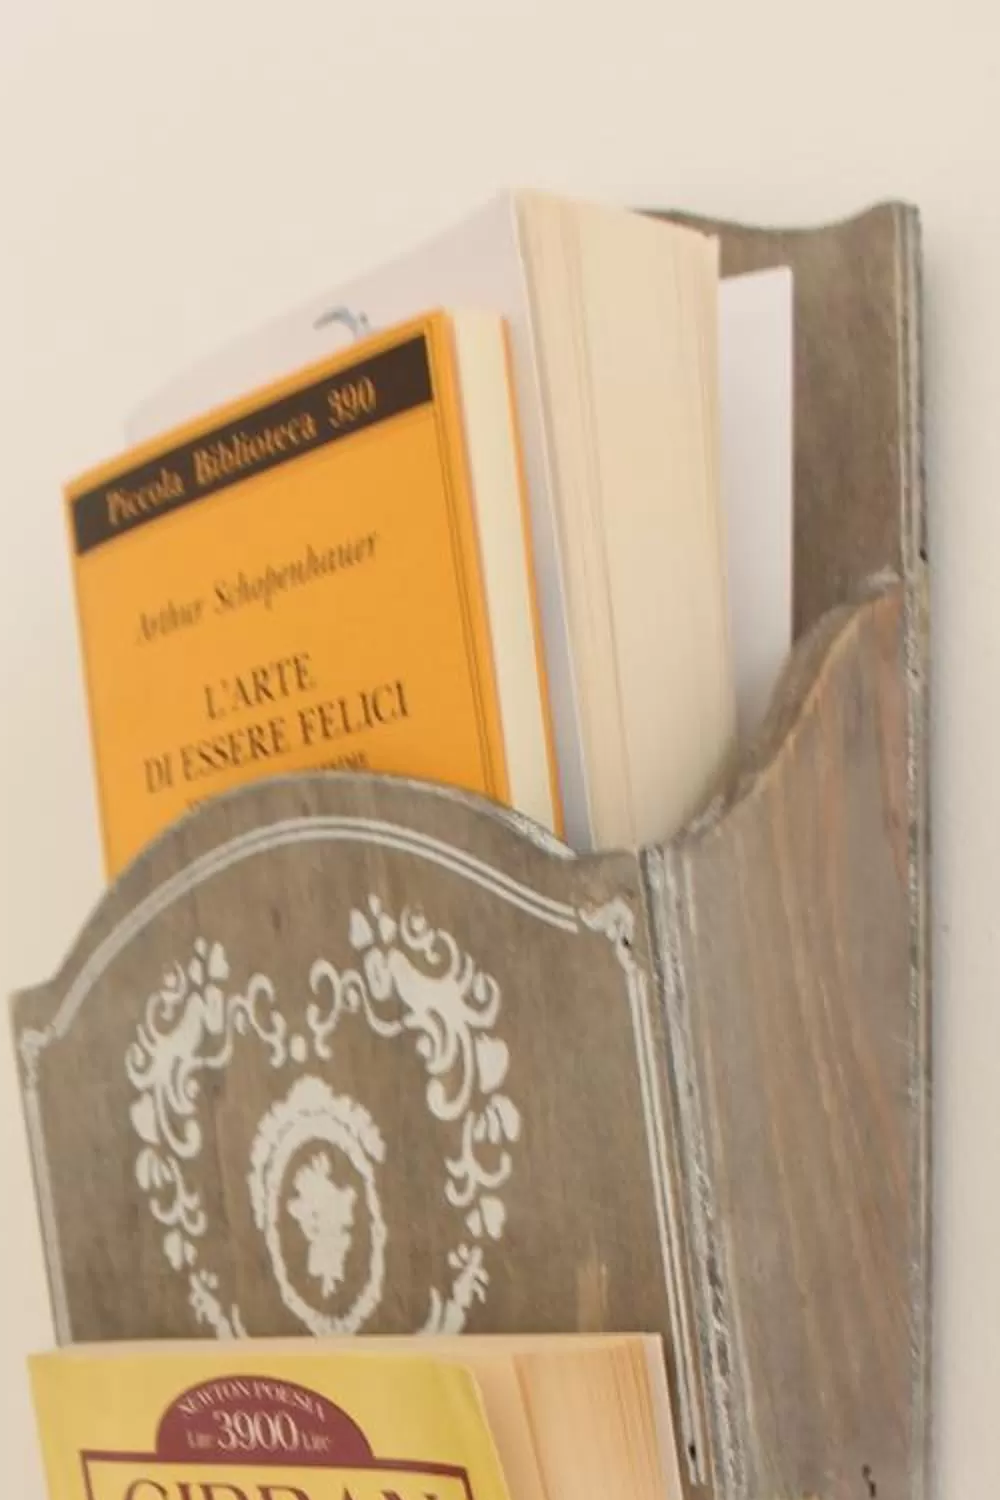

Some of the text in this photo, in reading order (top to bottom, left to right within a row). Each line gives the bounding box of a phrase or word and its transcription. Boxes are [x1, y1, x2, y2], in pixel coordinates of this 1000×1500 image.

[104, 375, 376, 526] Piccola Biblioteca 390
[136, 531, 379, 645] Arthur Schopenhauer
[143, 679, 410, 794] DI ESSERE FELICI
[204, 651, 318, 720] L'ARTE
[212, 1409, 299, 1451] 3900
